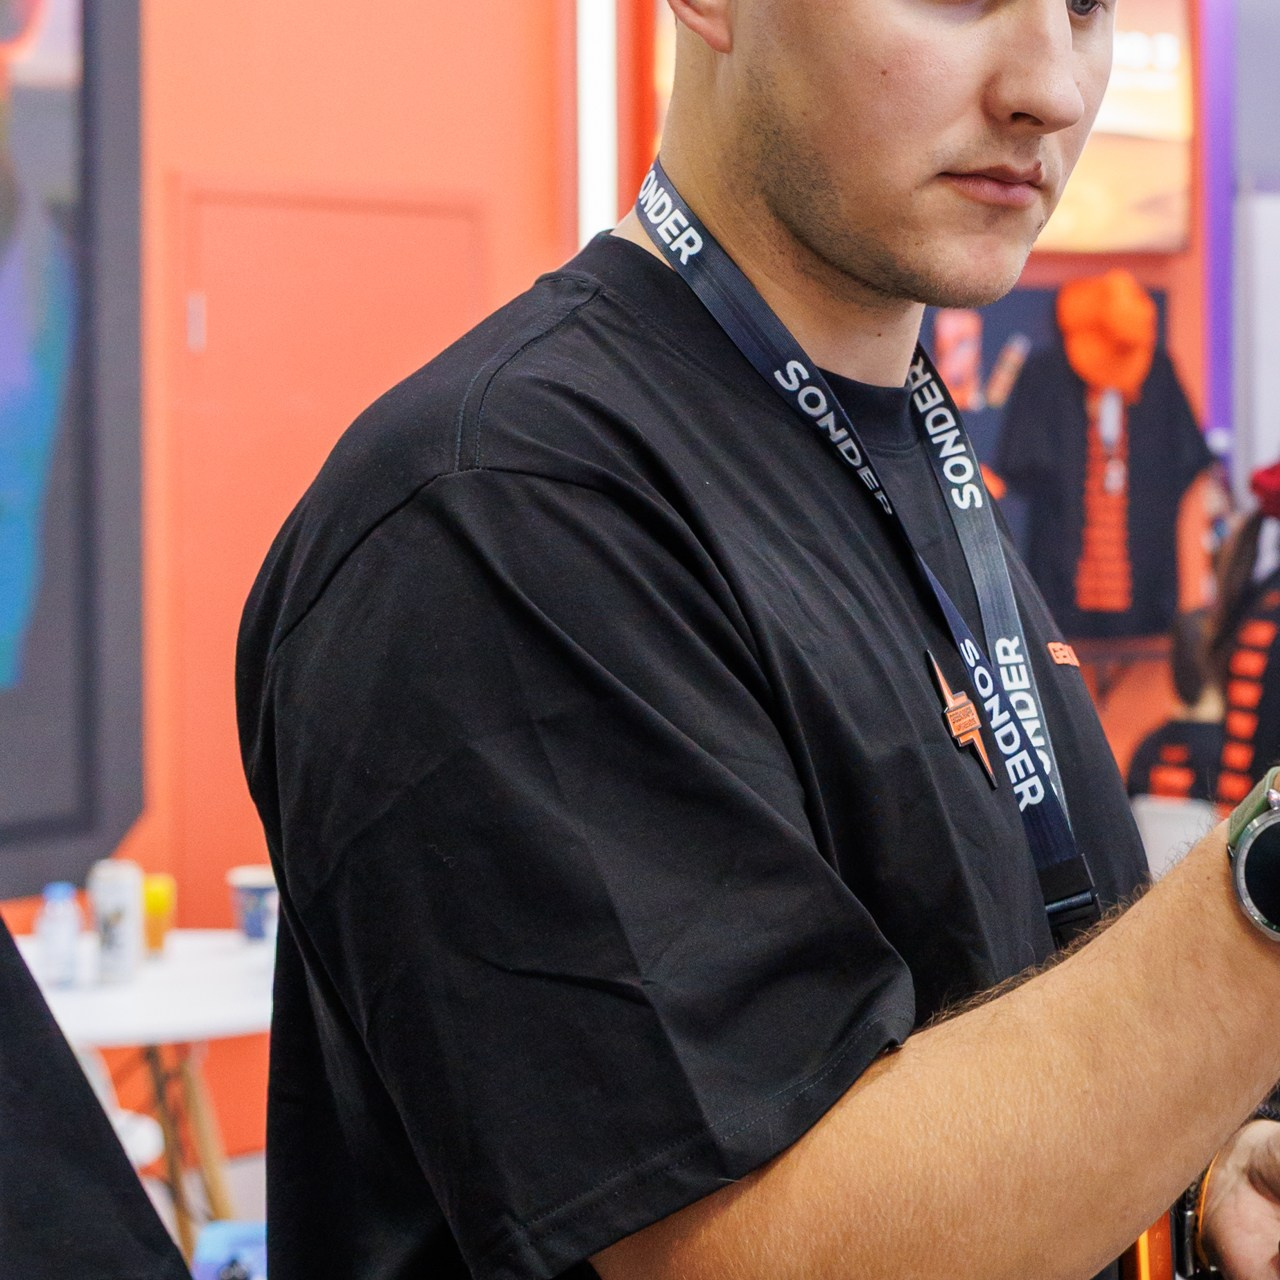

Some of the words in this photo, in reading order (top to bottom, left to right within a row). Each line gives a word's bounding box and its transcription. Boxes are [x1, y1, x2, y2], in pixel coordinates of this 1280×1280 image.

[638, 163, 704, 266] ONDER
[773, 359, 893, 516] SONDER
[907, 355, 983, 510] SONDER
[960, 638, 1045, 812] SONDER
